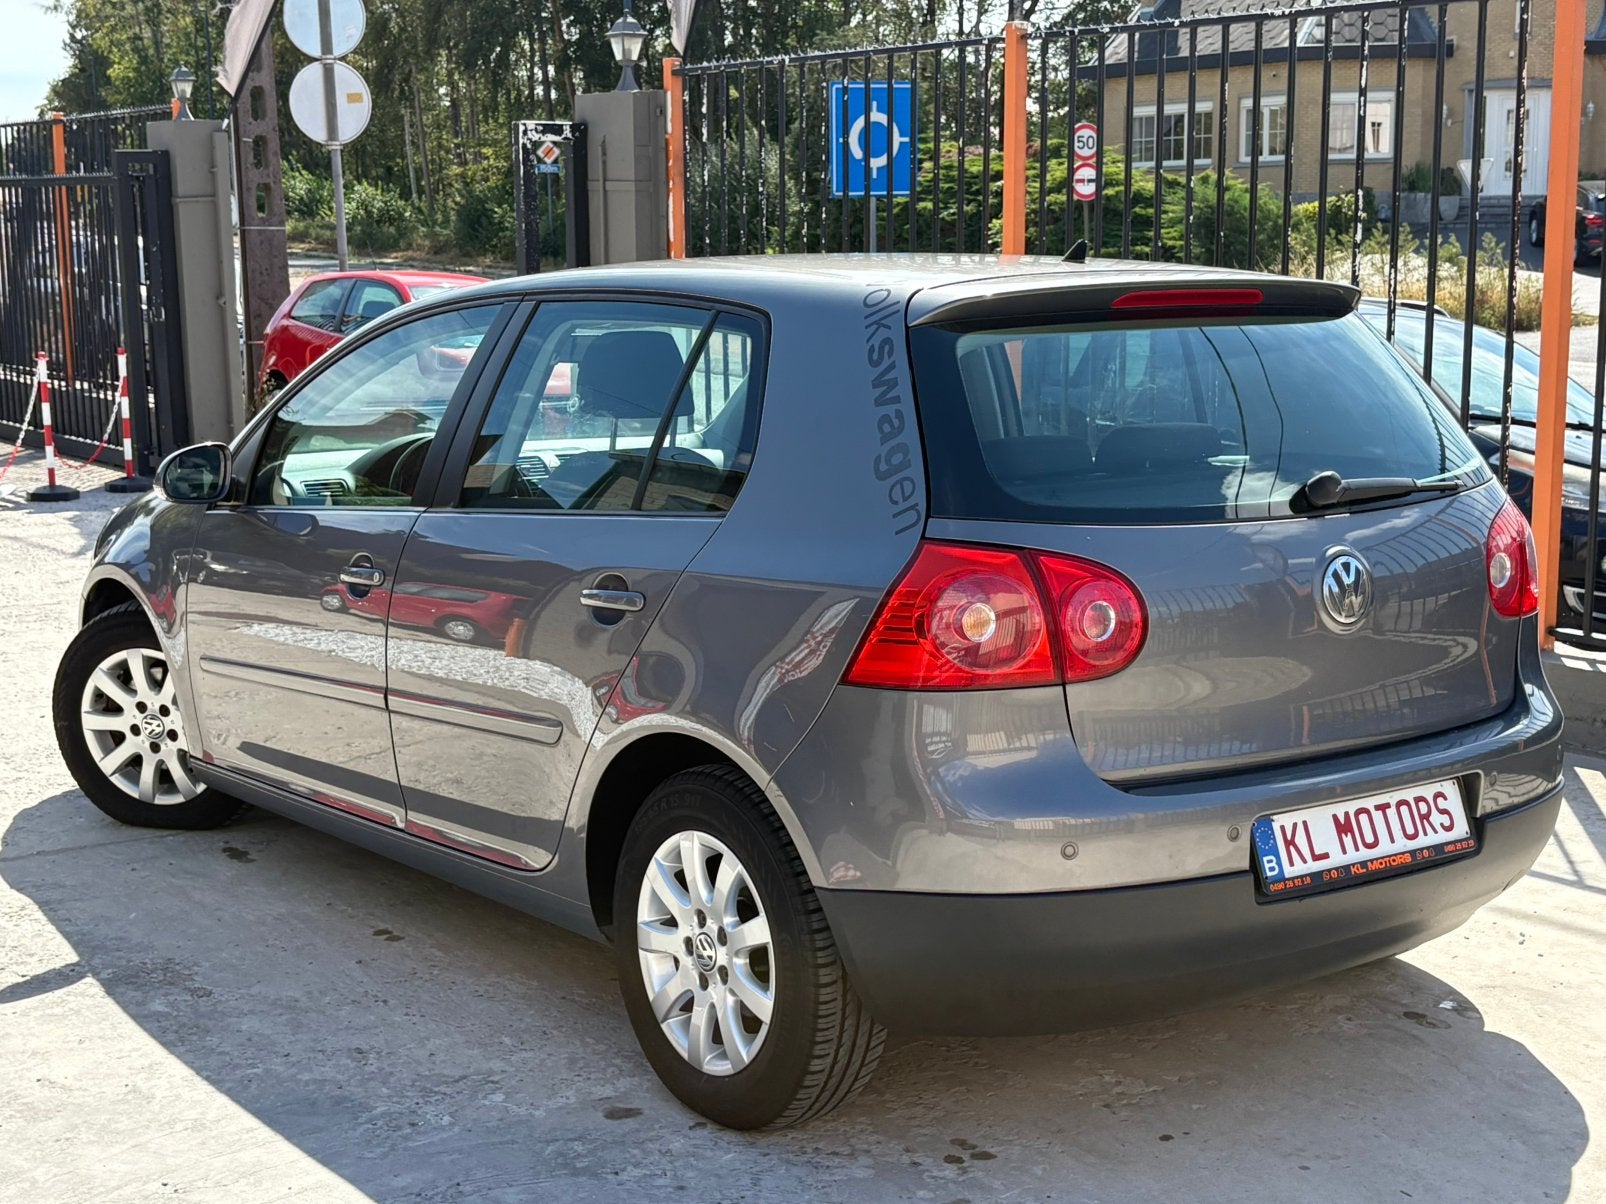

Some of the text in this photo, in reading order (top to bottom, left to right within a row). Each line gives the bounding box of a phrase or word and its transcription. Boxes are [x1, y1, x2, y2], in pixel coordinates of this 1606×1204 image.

[1076, 135, 1095, 150] 50
[1280, 791, 1455, 867] KL MOTORS
[1263, 855, 1279, 877] B
[1350, 863, 1367, 875] KL
[1367, 852, 1412, 871] MOTORS
